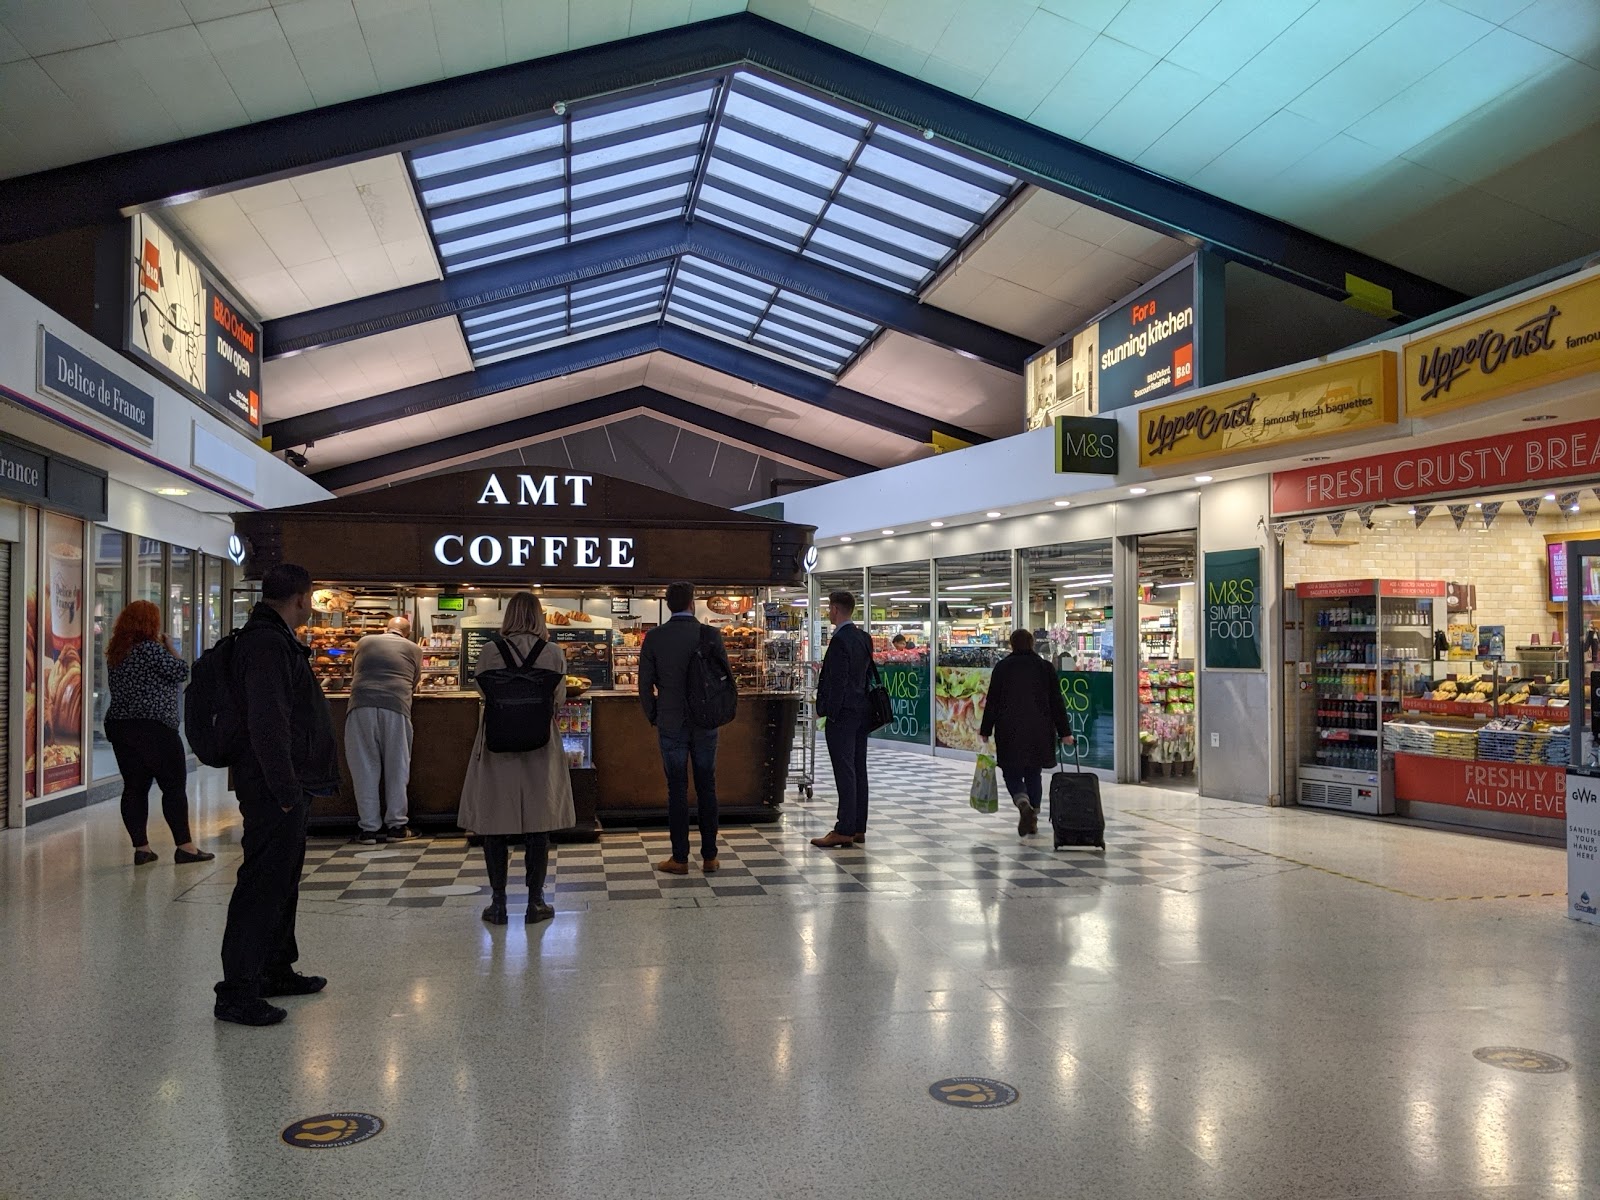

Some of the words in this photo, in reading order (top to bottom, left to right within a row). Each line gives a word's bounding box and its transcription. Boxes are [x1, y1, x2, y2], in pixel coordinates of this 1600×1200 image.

[214, 296, 231, 331] B&Q
[231, 314, 254, 354] Oxford
[1132, 303, 1149, 326] For
[1149, 300, 1156, 316] a
[1101, 331, 1147, 370] stunning
[1148, 306, 1193, 346] kitchen
[217, 336, 234, 362] now
[233, 349, 250, 378] open
[1418, 329, 1494, 401] Upper
[1480, 305, 1561, 375] Crust
[1175, 362, 1191, 380] B&Q
[58, 355, 95, 398] Delice
[98, 379, 111, 407] de
[113, 387, 145, 426] France
[1147, 405, 1208, 456] Upper
[1197, 392, 1260, 440] Crust
[1263, 411, 1300, 426] famously
[1302, 406, 1323, 419] fresh
[1325, 397, 1373, 414] baguettes
[1066, 432, 1115, 458] M&S
[0, 458, 38, 487] rance
[1307, 465, 1383, 502] FRESH
[1393, 444, 1513, 490] CRUSTY
[476, 473, 593, 506] AMT
[434, 534, 635, 568] COFFEE
[1209, 578, 1255, 605] M&S
[1209, 604, 1255, 621] SIMPLY
[1209, 620, 1255, 639] FOOD
[884, 672, 918, 699] M&S
[1060, 678, 1089, 711] &S
[891, 699, 918, 716] IMPLY
[1517, 708, 1545, 717] FRESHLY
[1546, 710, 1569, 718] BAKED
[884, 716, 918, 737] OOD
[1465, 764, 1547, 791] FRESHLY
[1466, 787, 1492, 805] ALL
[1496, 790, 1529, 811] DAY,
[1534, 794, 1564, 813] EVE
[1572, 787, 1597, 804] GWR
[1573, 842, 1598, 853] HANDS
[1575, 834, 1595, 843] YOUR
[1576, 851, 1595, 860] HERE
